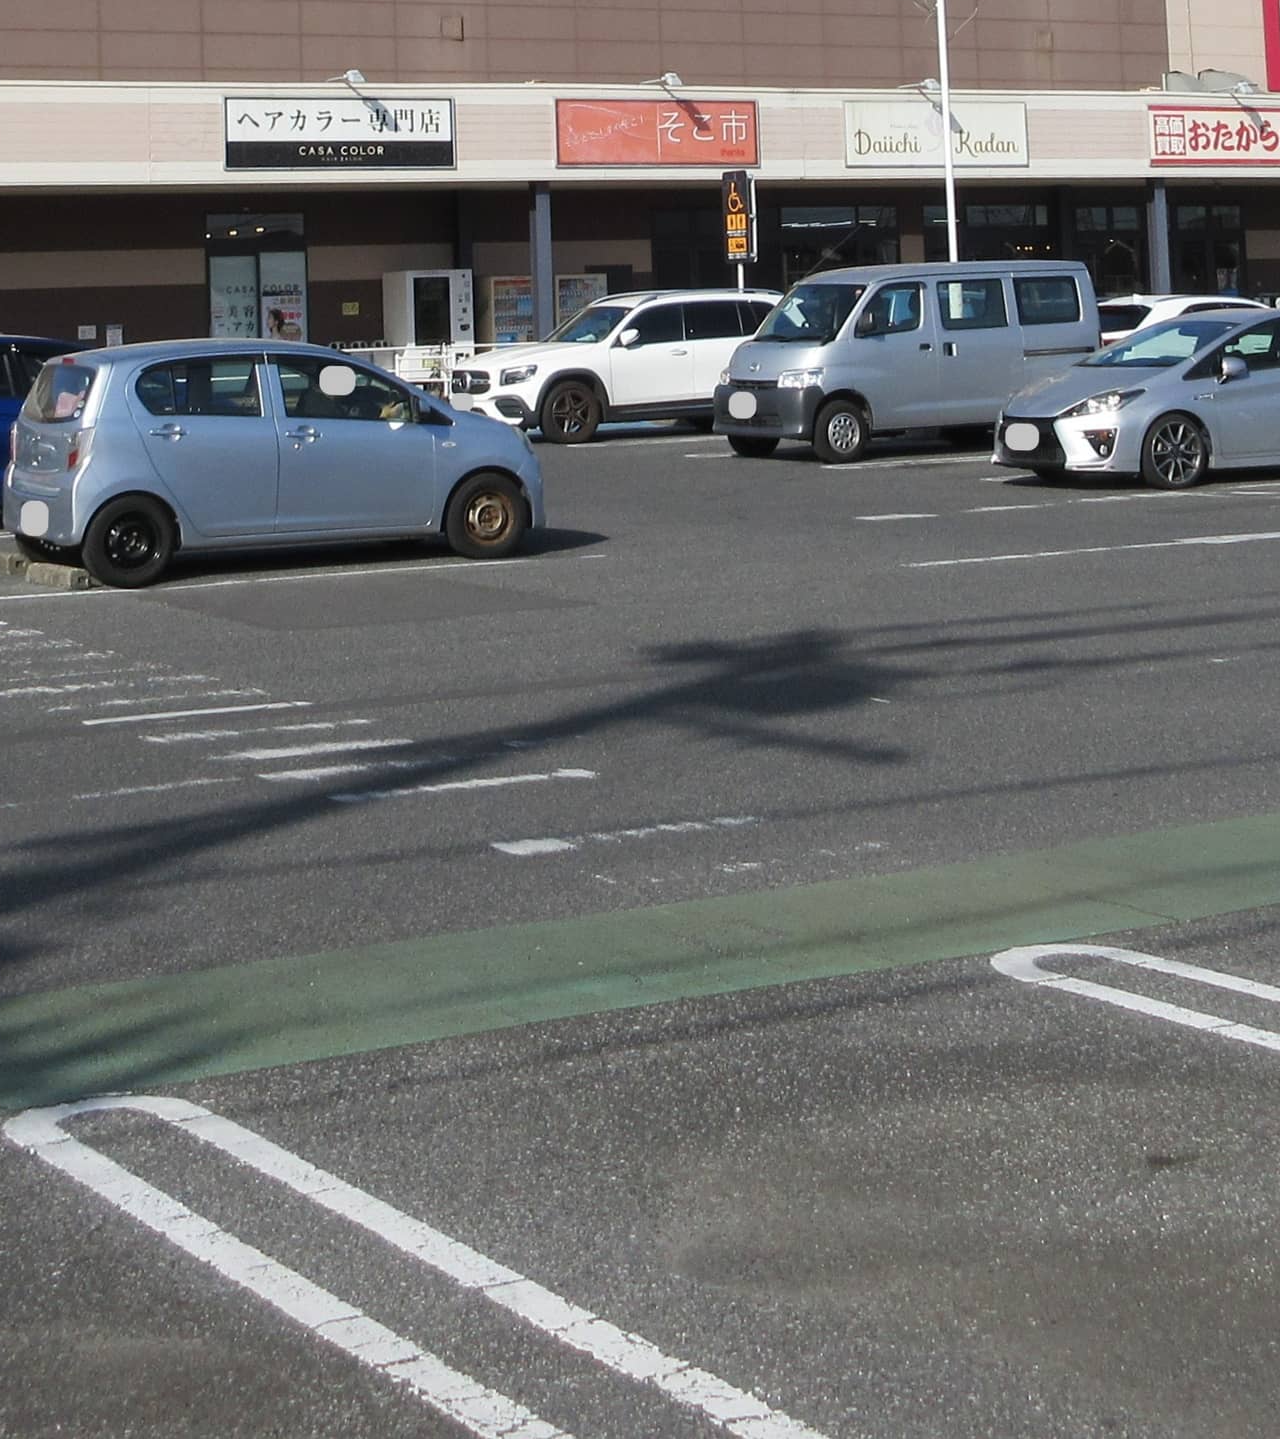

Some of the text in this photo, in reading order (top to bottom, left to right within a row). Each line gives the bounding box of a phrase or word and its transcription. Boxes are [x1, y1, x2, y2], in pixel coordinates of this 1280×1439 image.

[237, 108, 441, 134] ヘアカラー専門店
[658, 109, 749, 145] そこ市
[298, 145, 385, 156] CASA COLOR
[854, 128, 1018, 158] Daiichi Kadan
